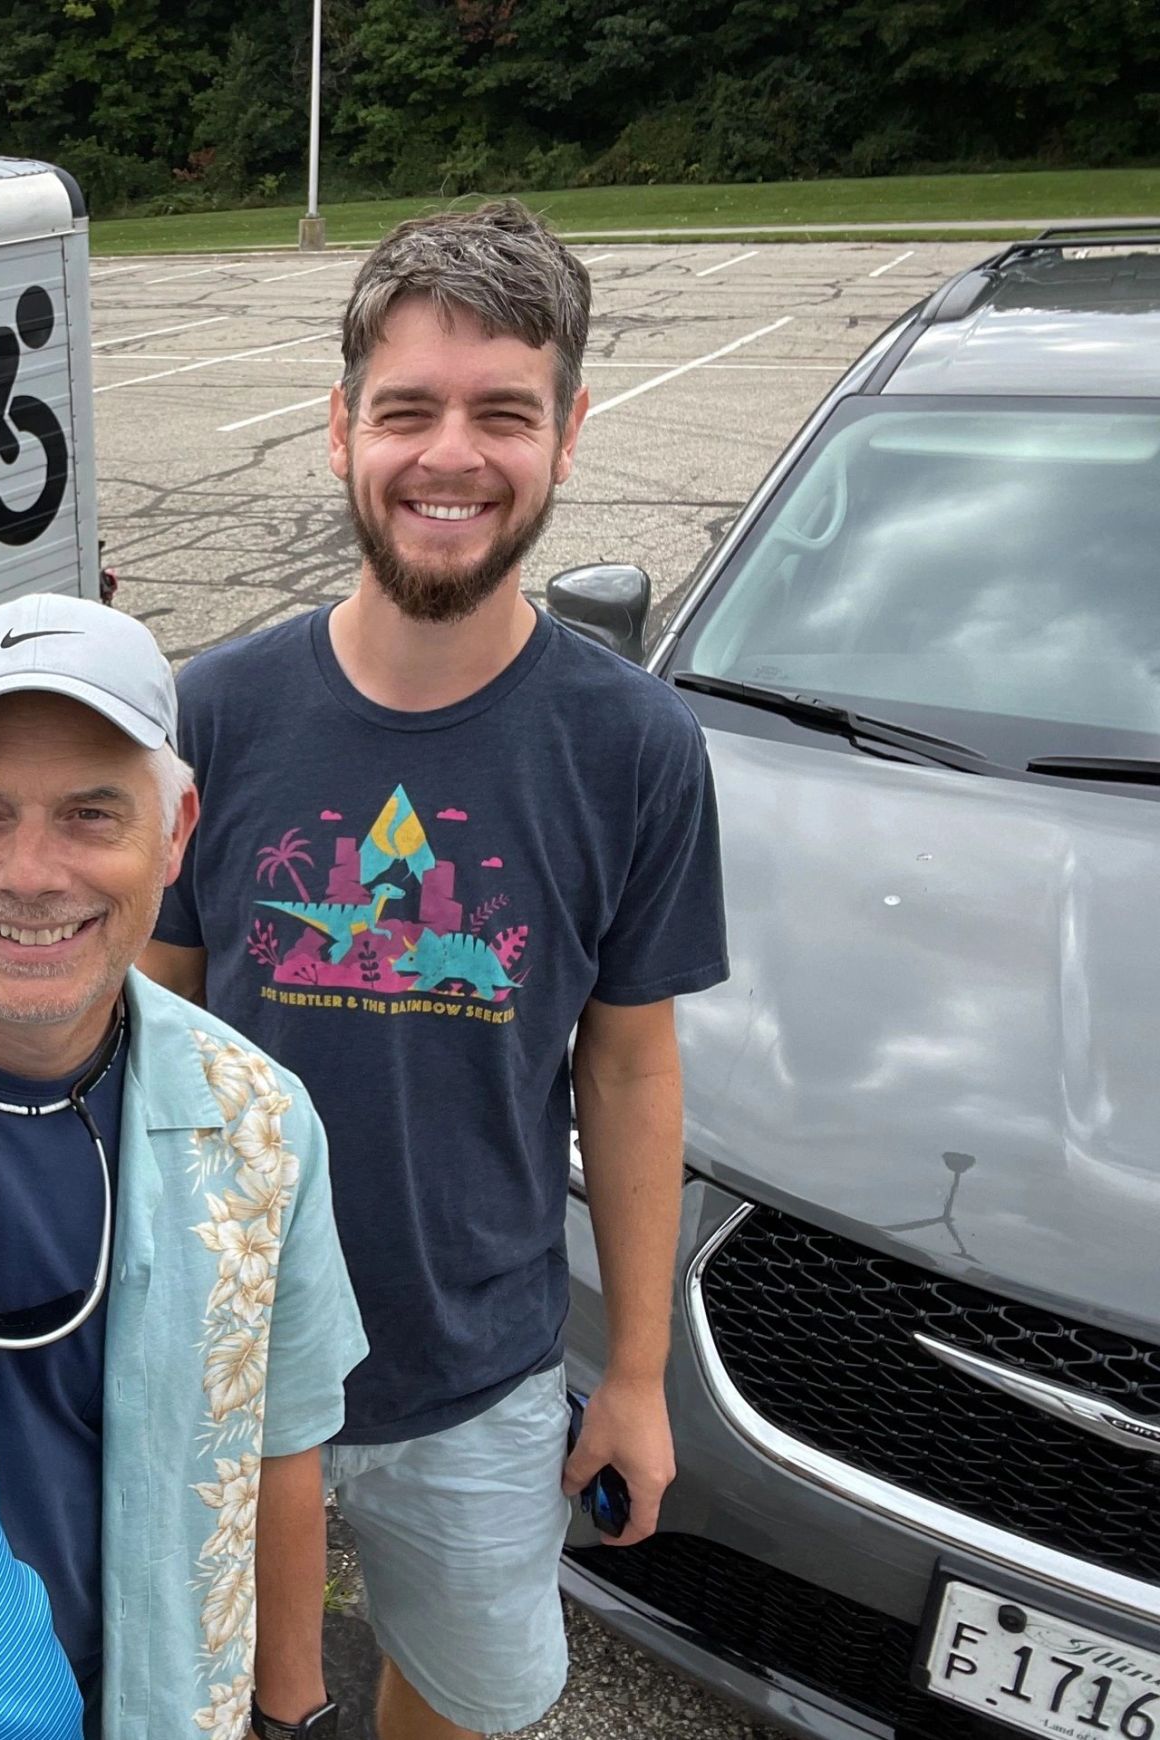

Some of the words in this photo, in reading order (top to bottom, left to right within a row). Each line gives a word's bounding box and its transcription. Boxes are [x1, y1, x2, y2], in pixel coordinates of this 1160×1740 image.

[279, 991, 343, 1008] HERTLER
[347, 996, 358, 1009] &
[362, 998, 386, 1014] THE
[391, 1000, 462, 1016] RAINBOW
[1000, 1646, 1160, 1740] 1716
